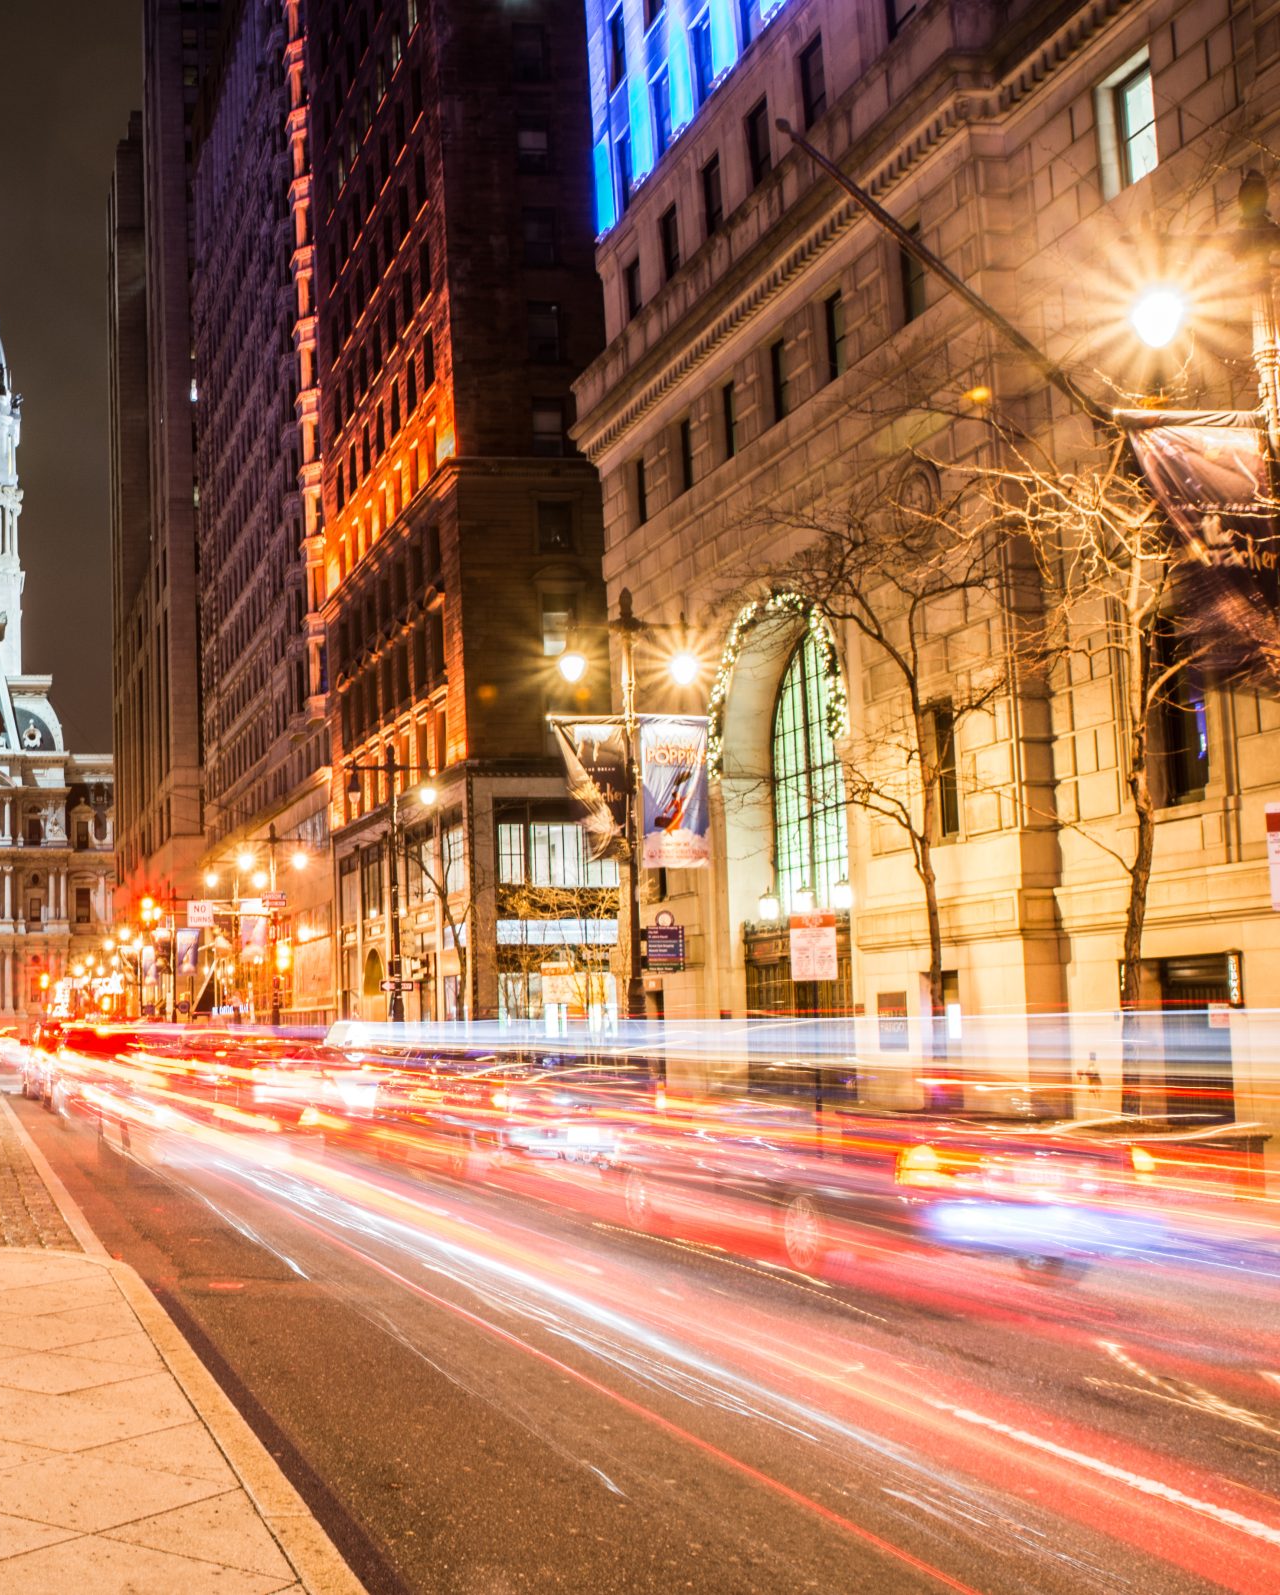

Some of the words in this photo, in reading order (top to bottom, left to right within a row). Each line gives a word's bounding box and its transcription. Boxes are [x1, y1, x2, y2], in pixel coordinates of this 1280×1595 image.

[193, 904, 207, 913] NO
[190, 916, 212, 924] TURNS
[1228, 955, 1239, 1003] SUBWAY
